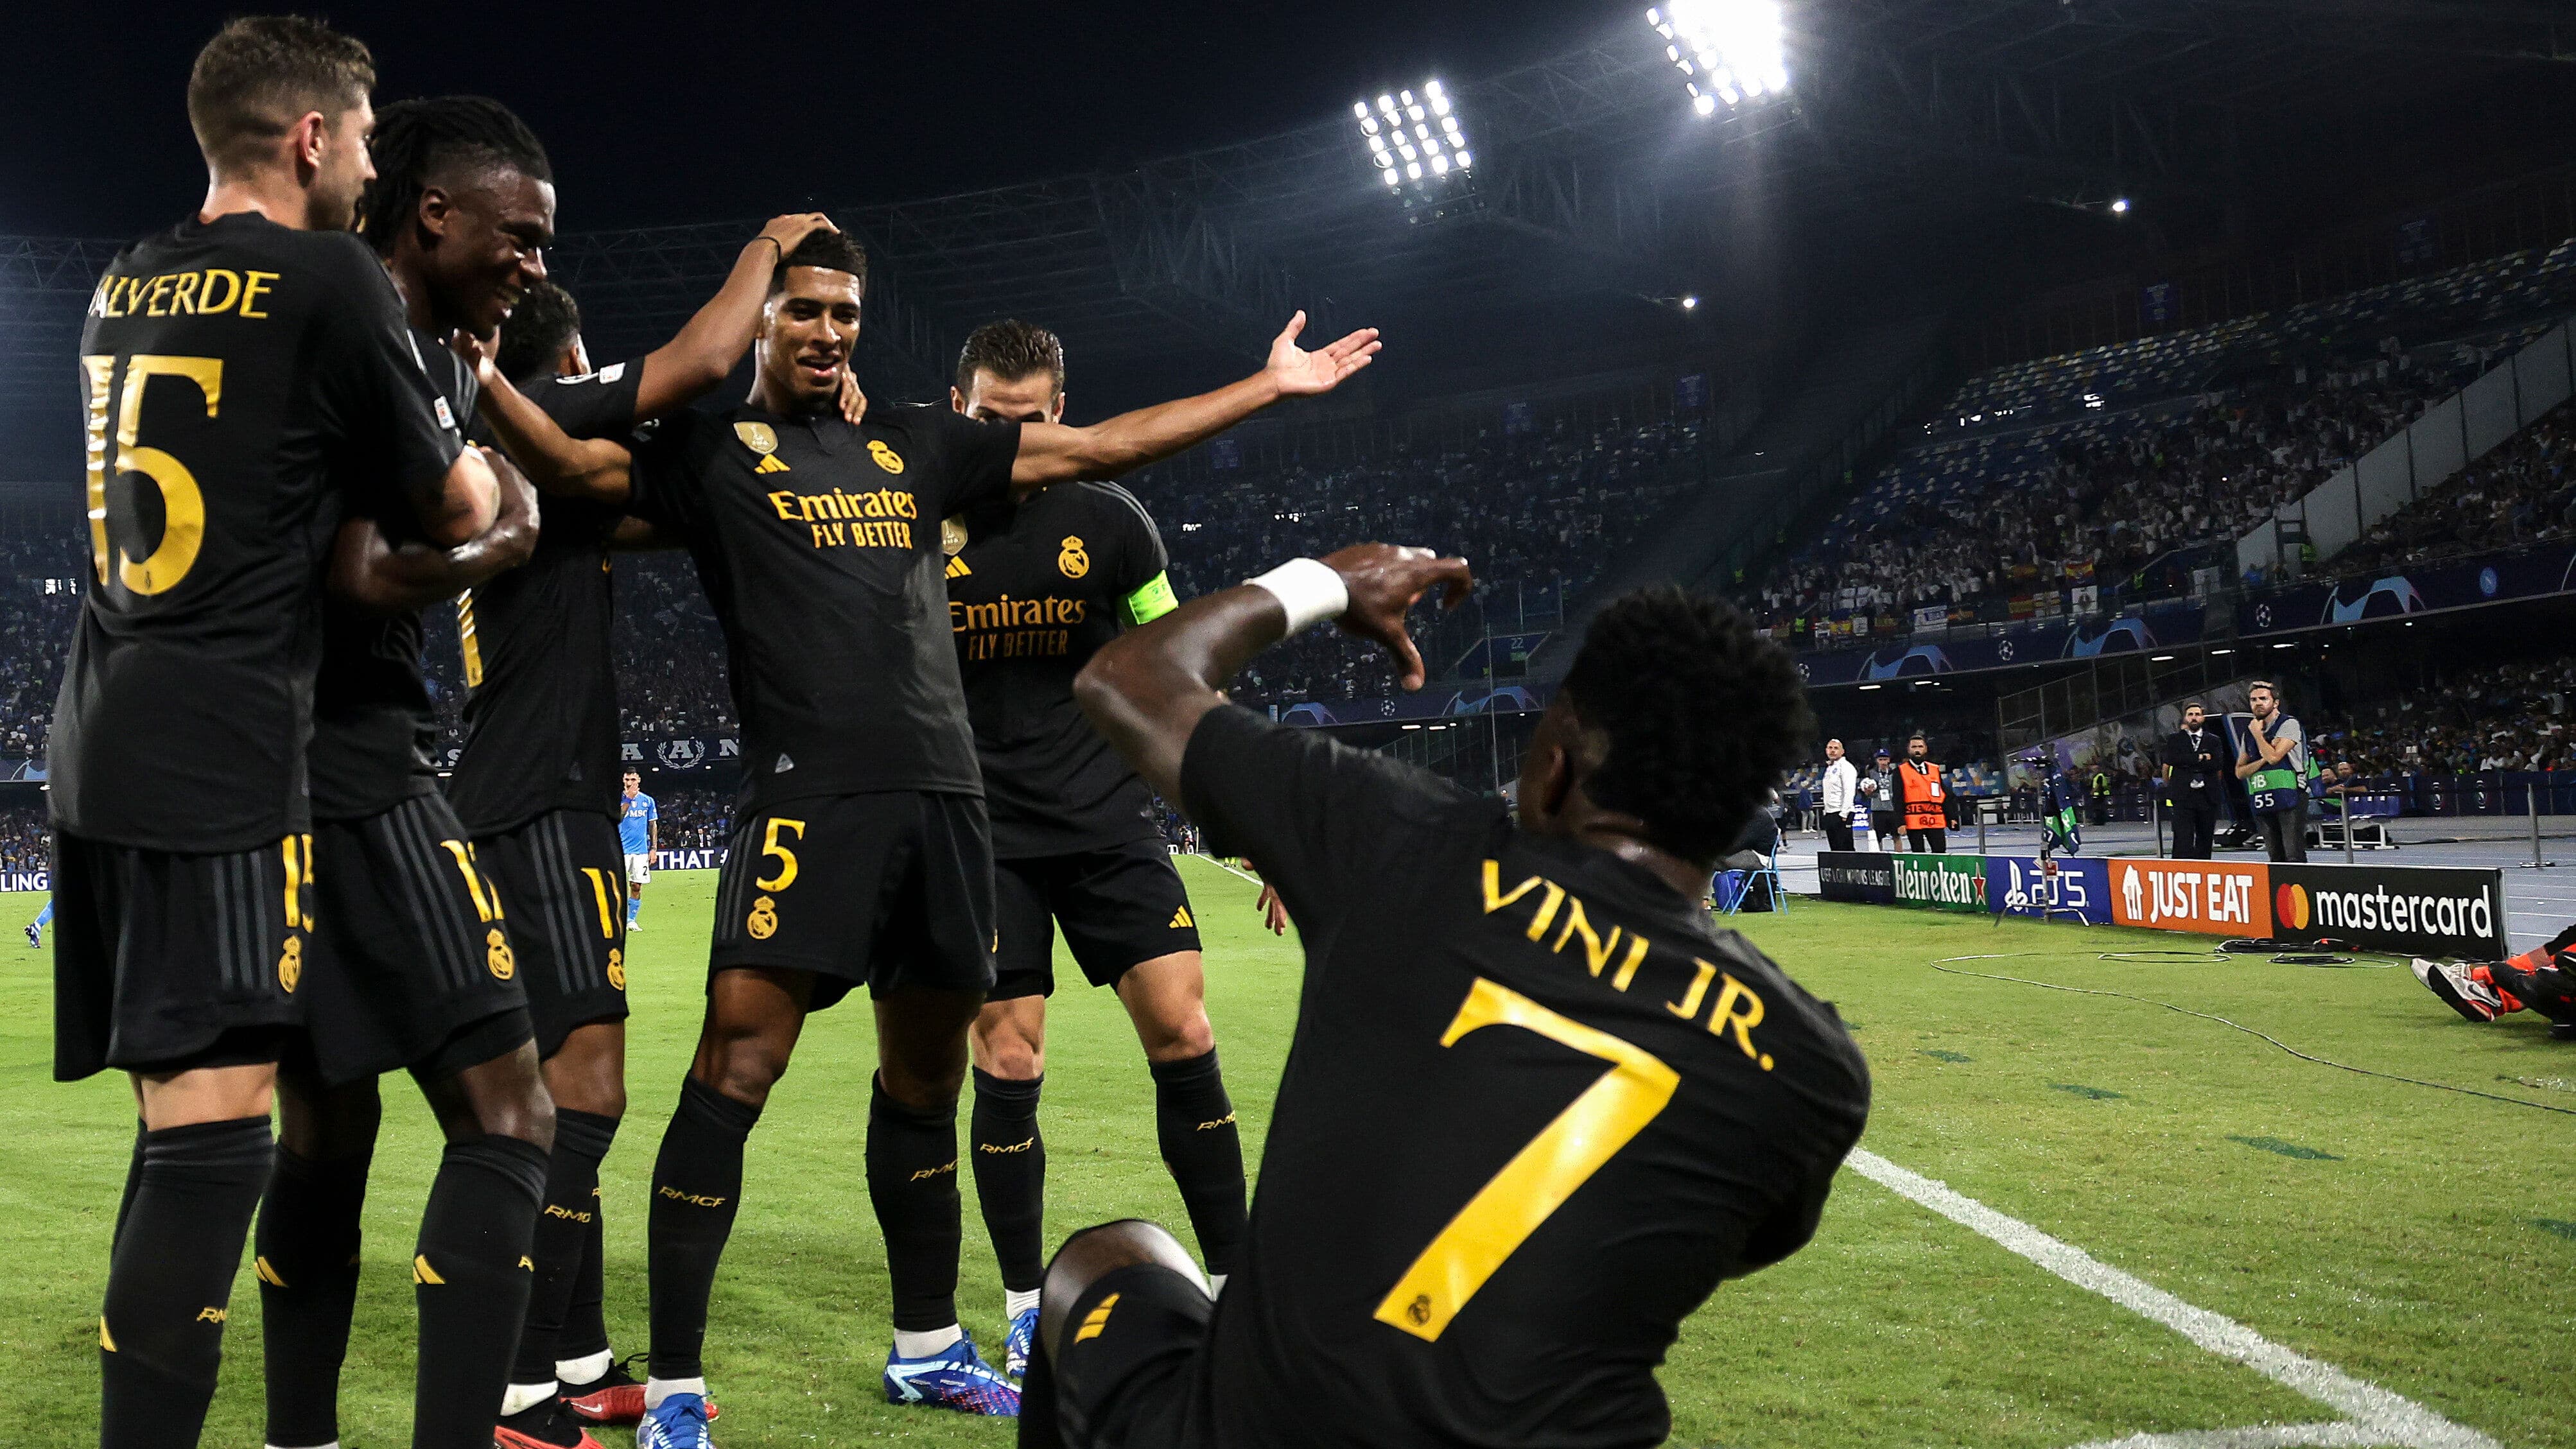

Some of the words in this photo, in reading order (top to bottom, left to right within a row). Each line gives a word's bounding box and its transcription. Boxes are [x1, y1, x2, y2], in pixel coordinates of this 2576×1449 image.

[82, 354, 223, 596] 15
[767, 487, 918, 522] Emirates
[810, 521, 846, 549] FLY
[851, 521, 913, 550] BETTER
[948, 593, 1086, 632] Emirates
[968, 634, 998, 661] FLY
[1004, 629, 1069, 657] BETTER
[2254, 793, 2274, 808] 55
[656, 849, 715, 869] THAT
[755, 817, 806, 892] 5
[1893, 859, 1972, 905] Heineken
[2148, 871, 2202, 924] JUST
[2206, 873, 2254, 924] EAT
[2315, 884, 2493, 938] mastercard
[1482, 859, 1650, 993] VINI
[1666, 956, 1775, 1072] JR.
[1373, 976, 1681, 1343] 7
[658, 1186, 726, 1208] RMCF
